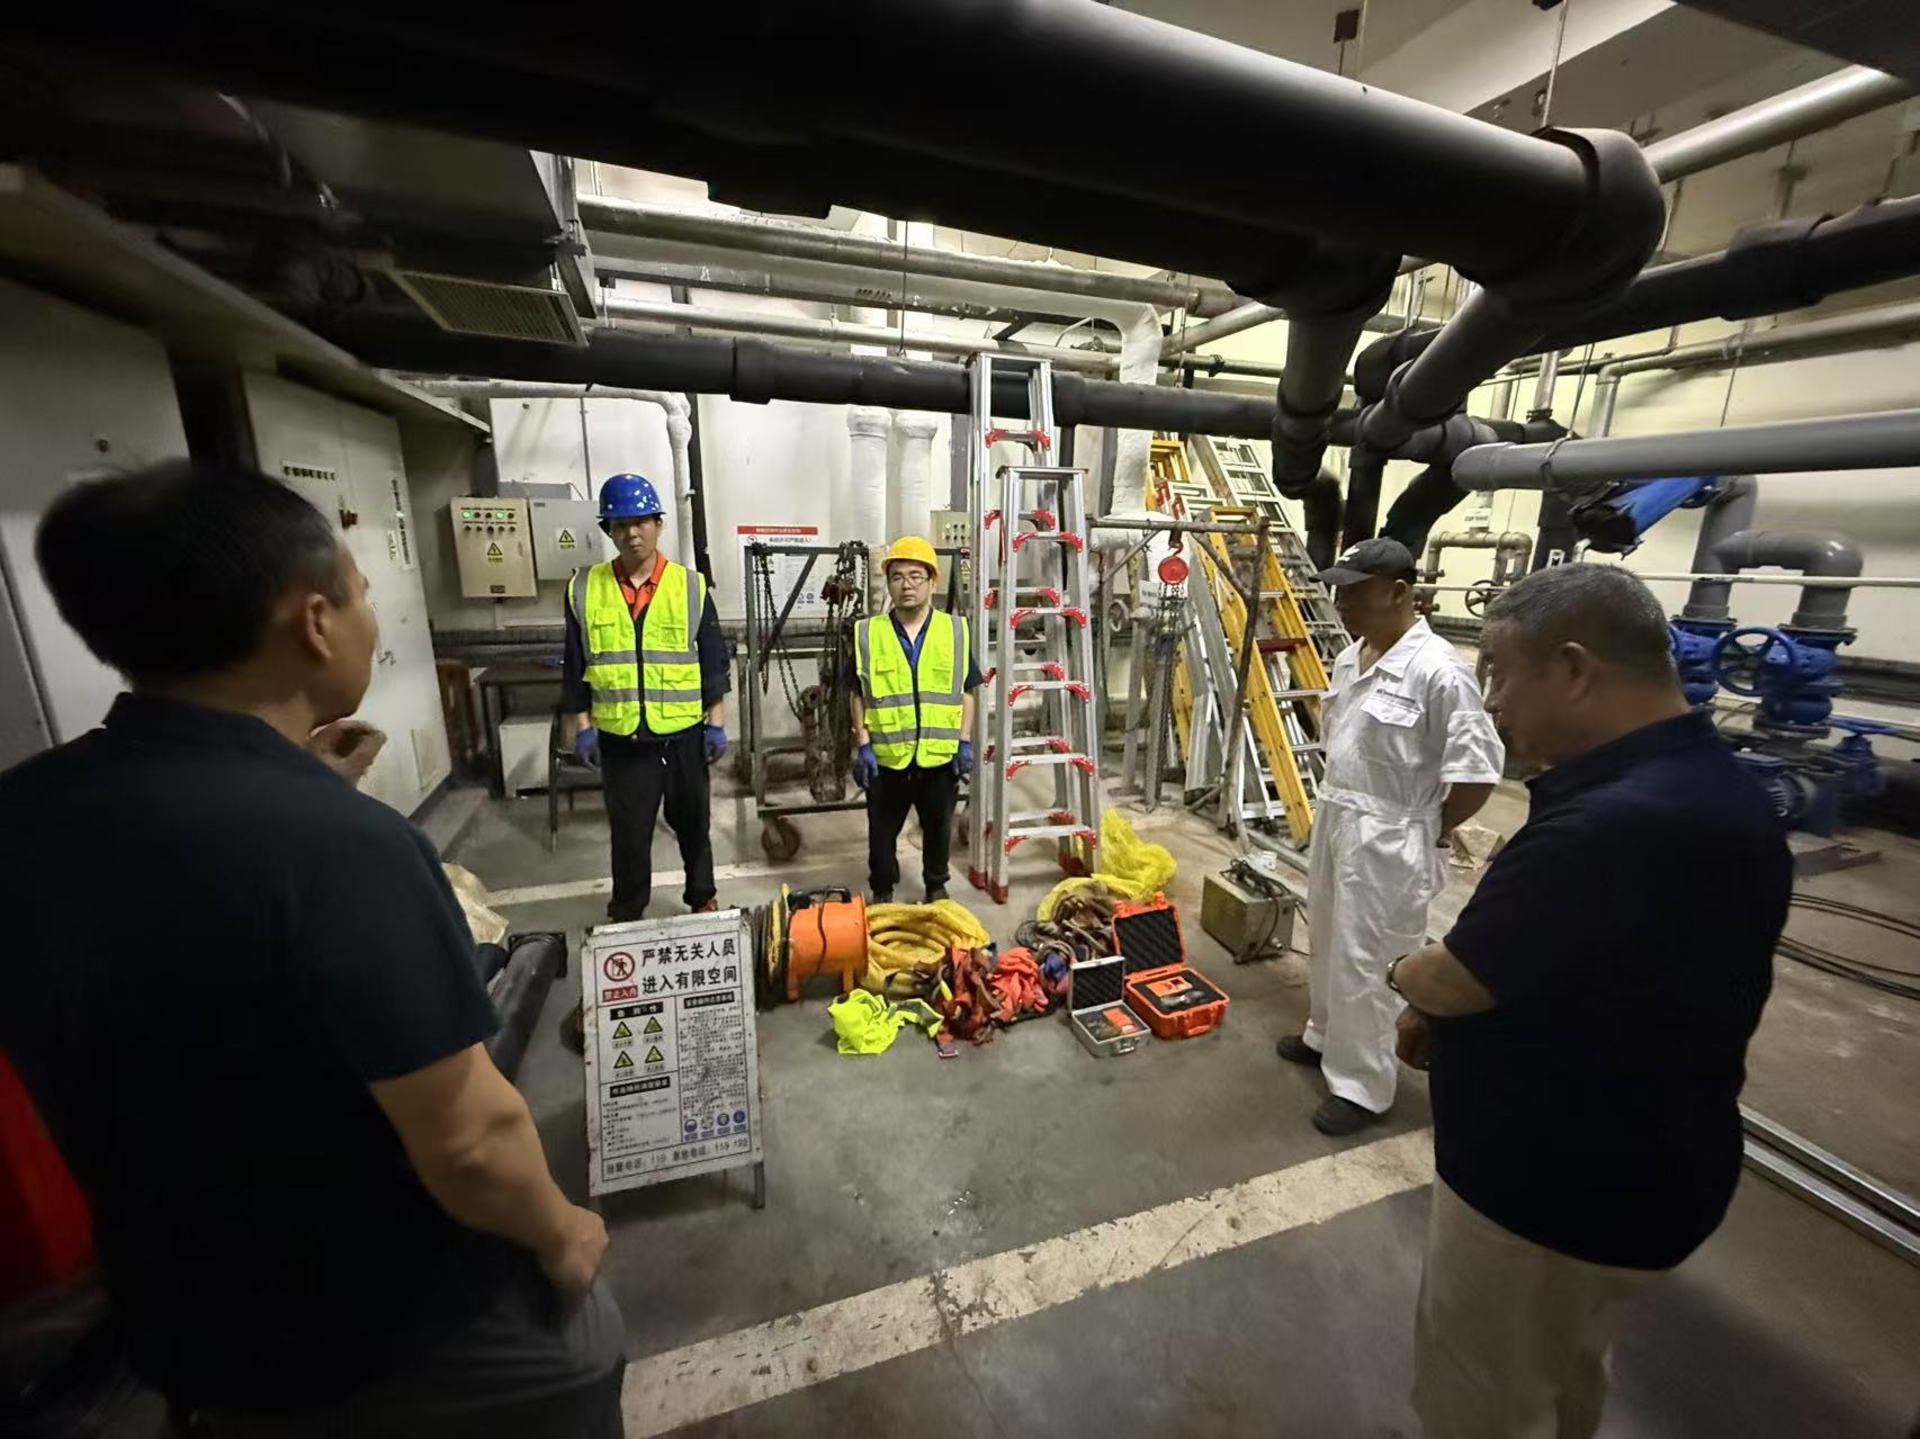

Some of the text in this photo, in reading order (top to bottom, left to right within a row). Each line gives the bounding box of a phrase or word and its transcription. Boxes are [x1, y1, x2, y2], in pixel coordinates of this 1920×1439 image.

[641, 938, 736, 967] 严禁无关人员
[642, 965, 738, 995] 进入有限空间
